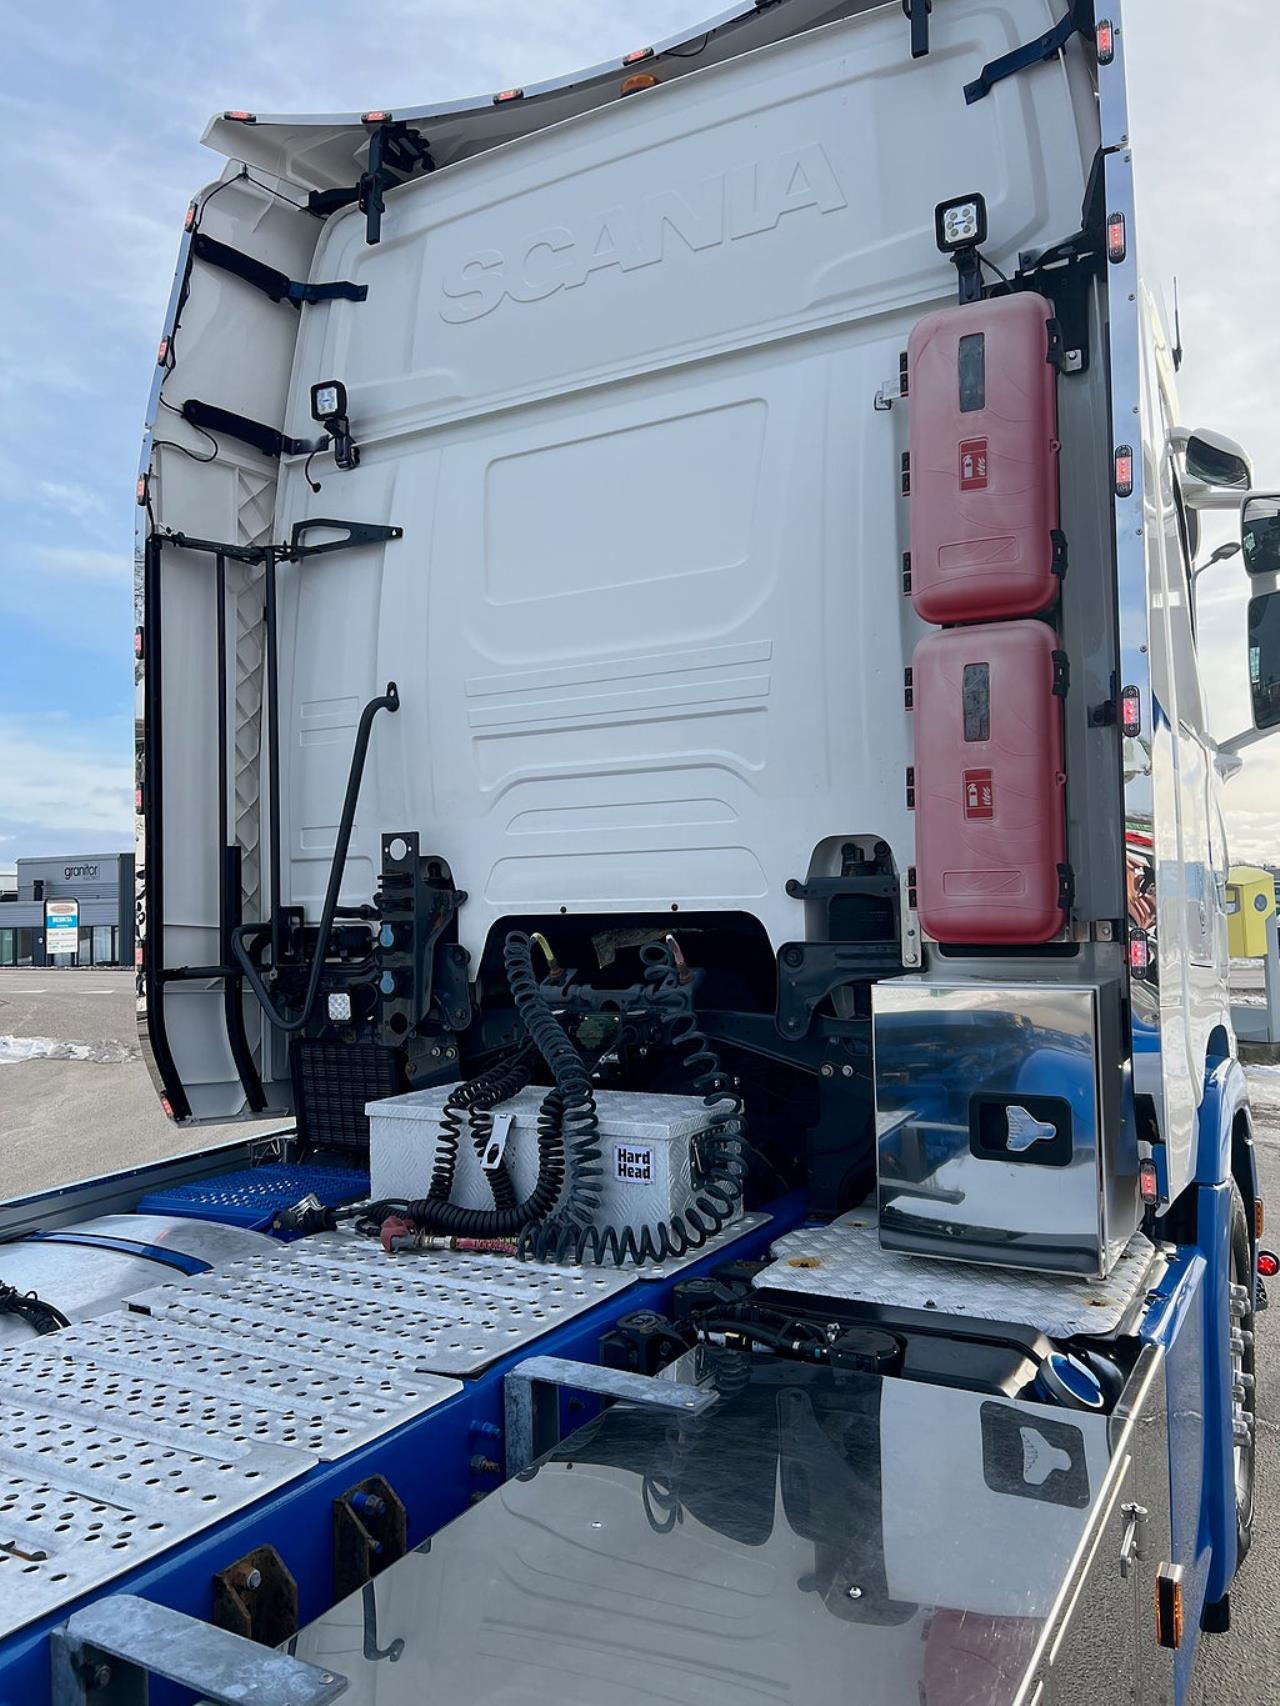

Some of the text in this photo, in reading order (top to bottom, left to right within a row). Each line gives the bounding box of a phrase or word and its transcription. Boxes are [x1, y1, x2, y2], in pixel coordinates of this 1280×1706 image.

[440, 143, 847, 324] SCANIA
[64, 864, 98, 880] granitor
[618, 1148, 651, 1165] Hard
[618, 1163, 651, 1179] Head
